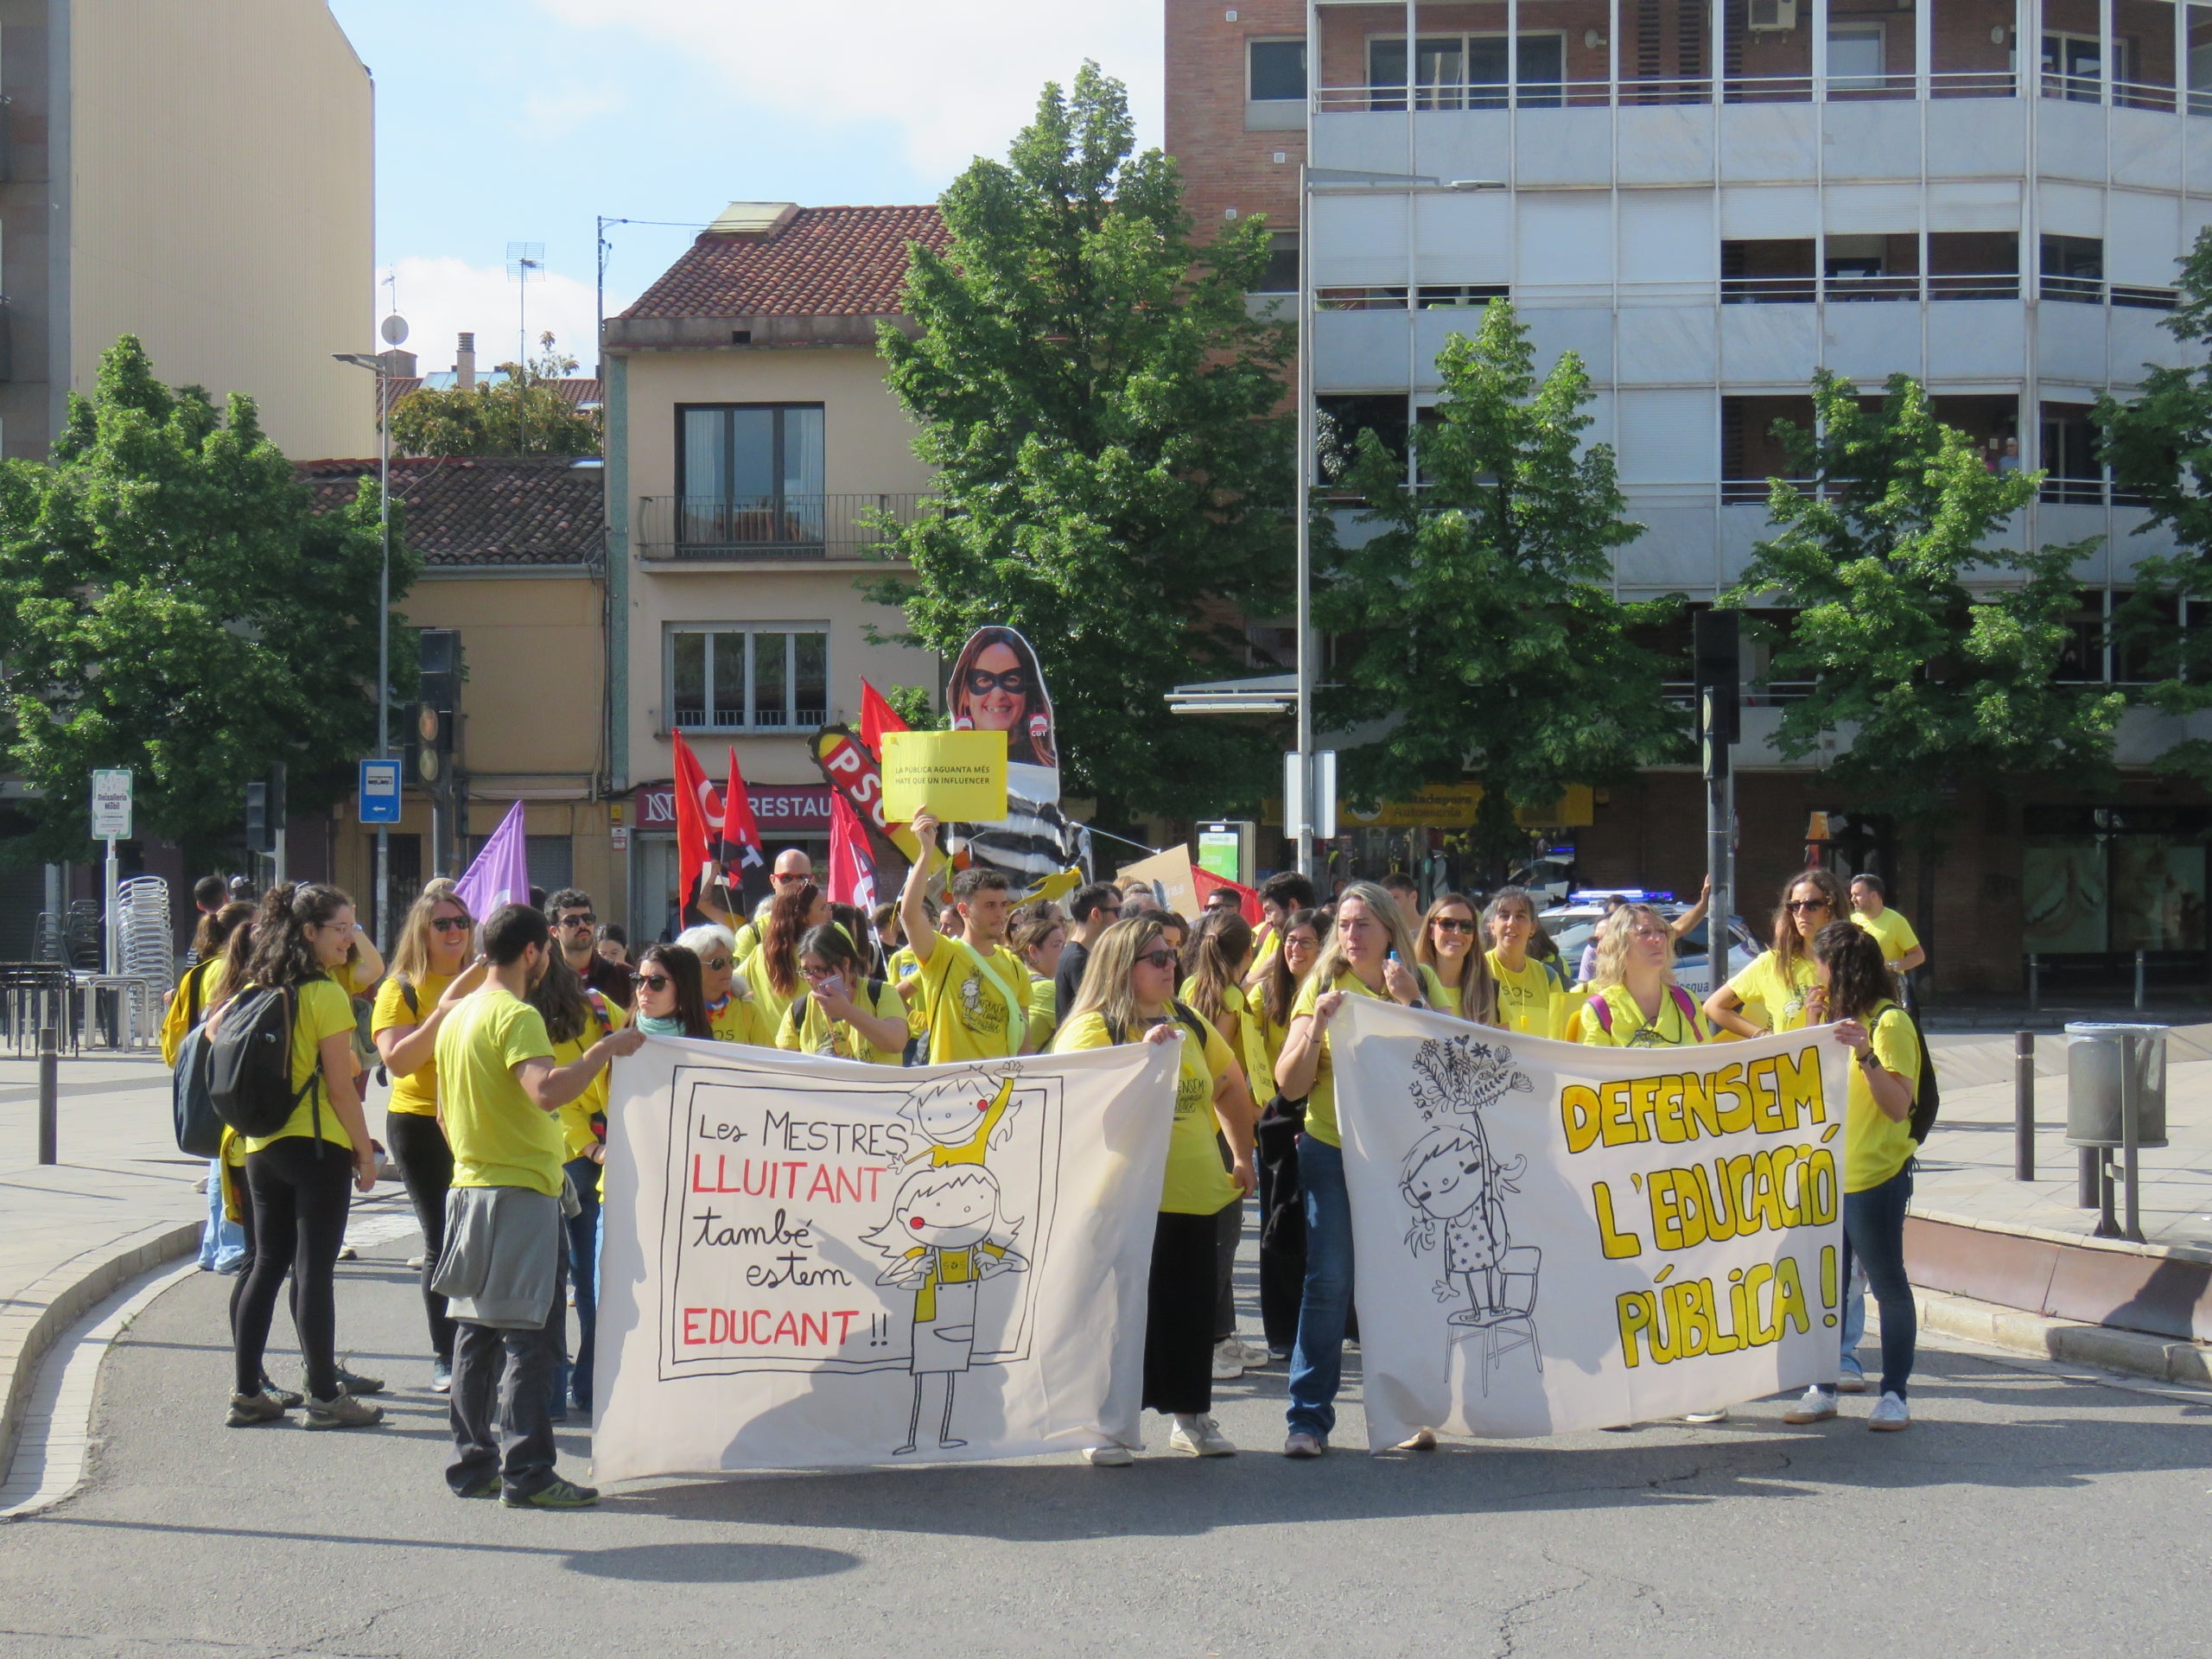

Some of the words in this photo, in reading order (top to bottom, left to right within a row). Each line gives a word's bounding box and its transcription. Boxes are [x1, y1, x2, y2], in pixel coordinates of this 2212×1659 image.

[974, 765, 990, 773] MÉS
[1502, 986, 1534, 998] SOS
[714, 1029, 734, 1040] OS
[1177, 1078, 1205, 1094] ENSEM
[1560, 1046, 1826, 1154] DEFENSEM
[700, 1114, 747, 1142] Les
[763, 1109, 909, 1156] MESTRES
[693, 1154, 887, 1203] LLUITANT
[693, 1206, 813, 1248] també
[747, 1250, 852, 1288] estem
[683, 1307, 860, 1346] EDUCANT
